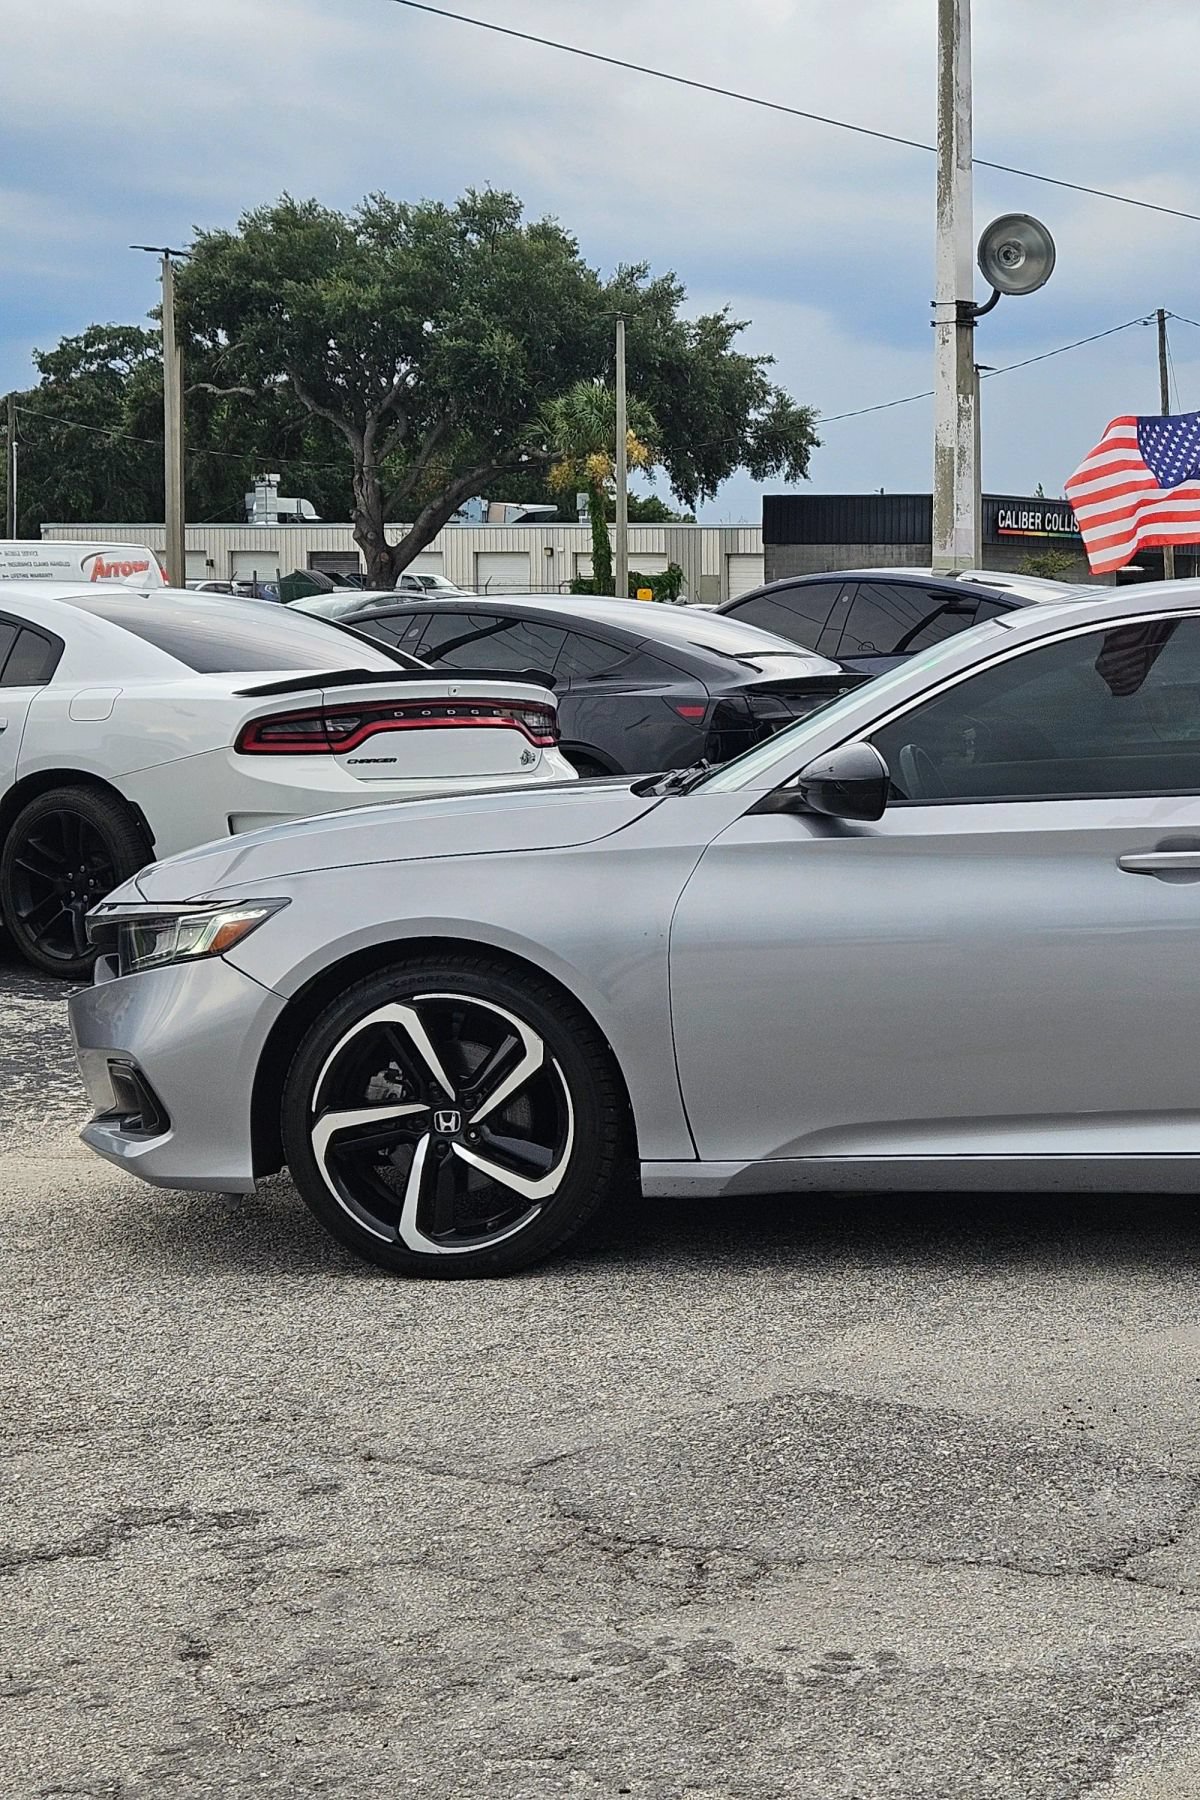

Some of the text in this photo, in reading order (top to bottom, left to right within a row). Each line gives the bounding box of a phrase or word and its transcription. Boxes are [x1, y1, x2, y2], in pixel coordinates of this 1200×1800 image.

[998, 510, 1080, 532] CALIBER COLLIS
[394, 709, 501, 717] DODGE
